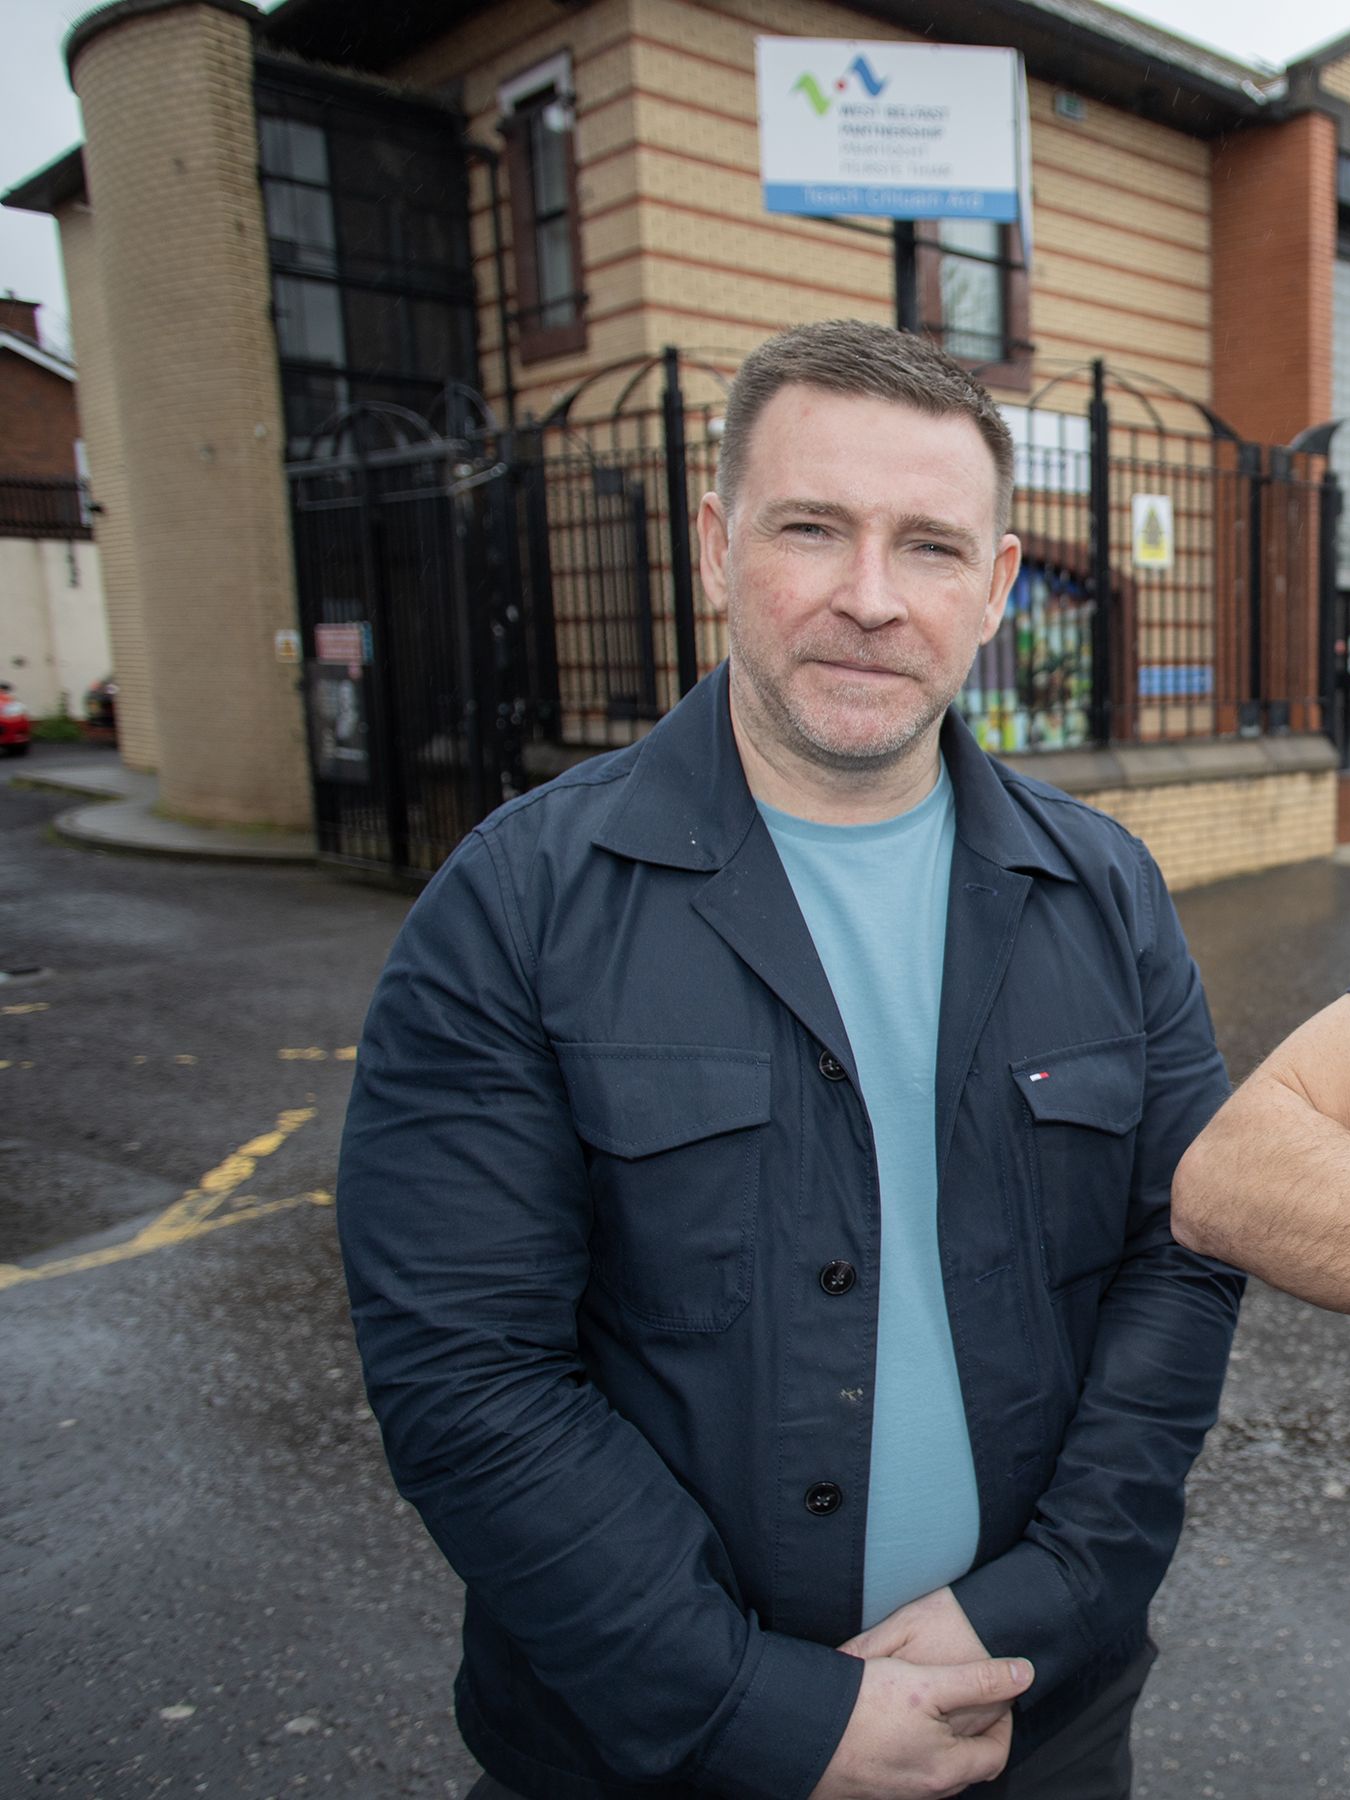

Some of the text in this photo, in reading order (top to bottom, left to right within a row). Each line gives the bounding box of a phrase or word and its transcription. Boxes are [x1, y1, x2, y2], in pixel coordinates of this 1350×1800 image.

[840, 103, 950, 120] WEST BELFAST
[840, 122, 945, 139] PARTNERSHIP
